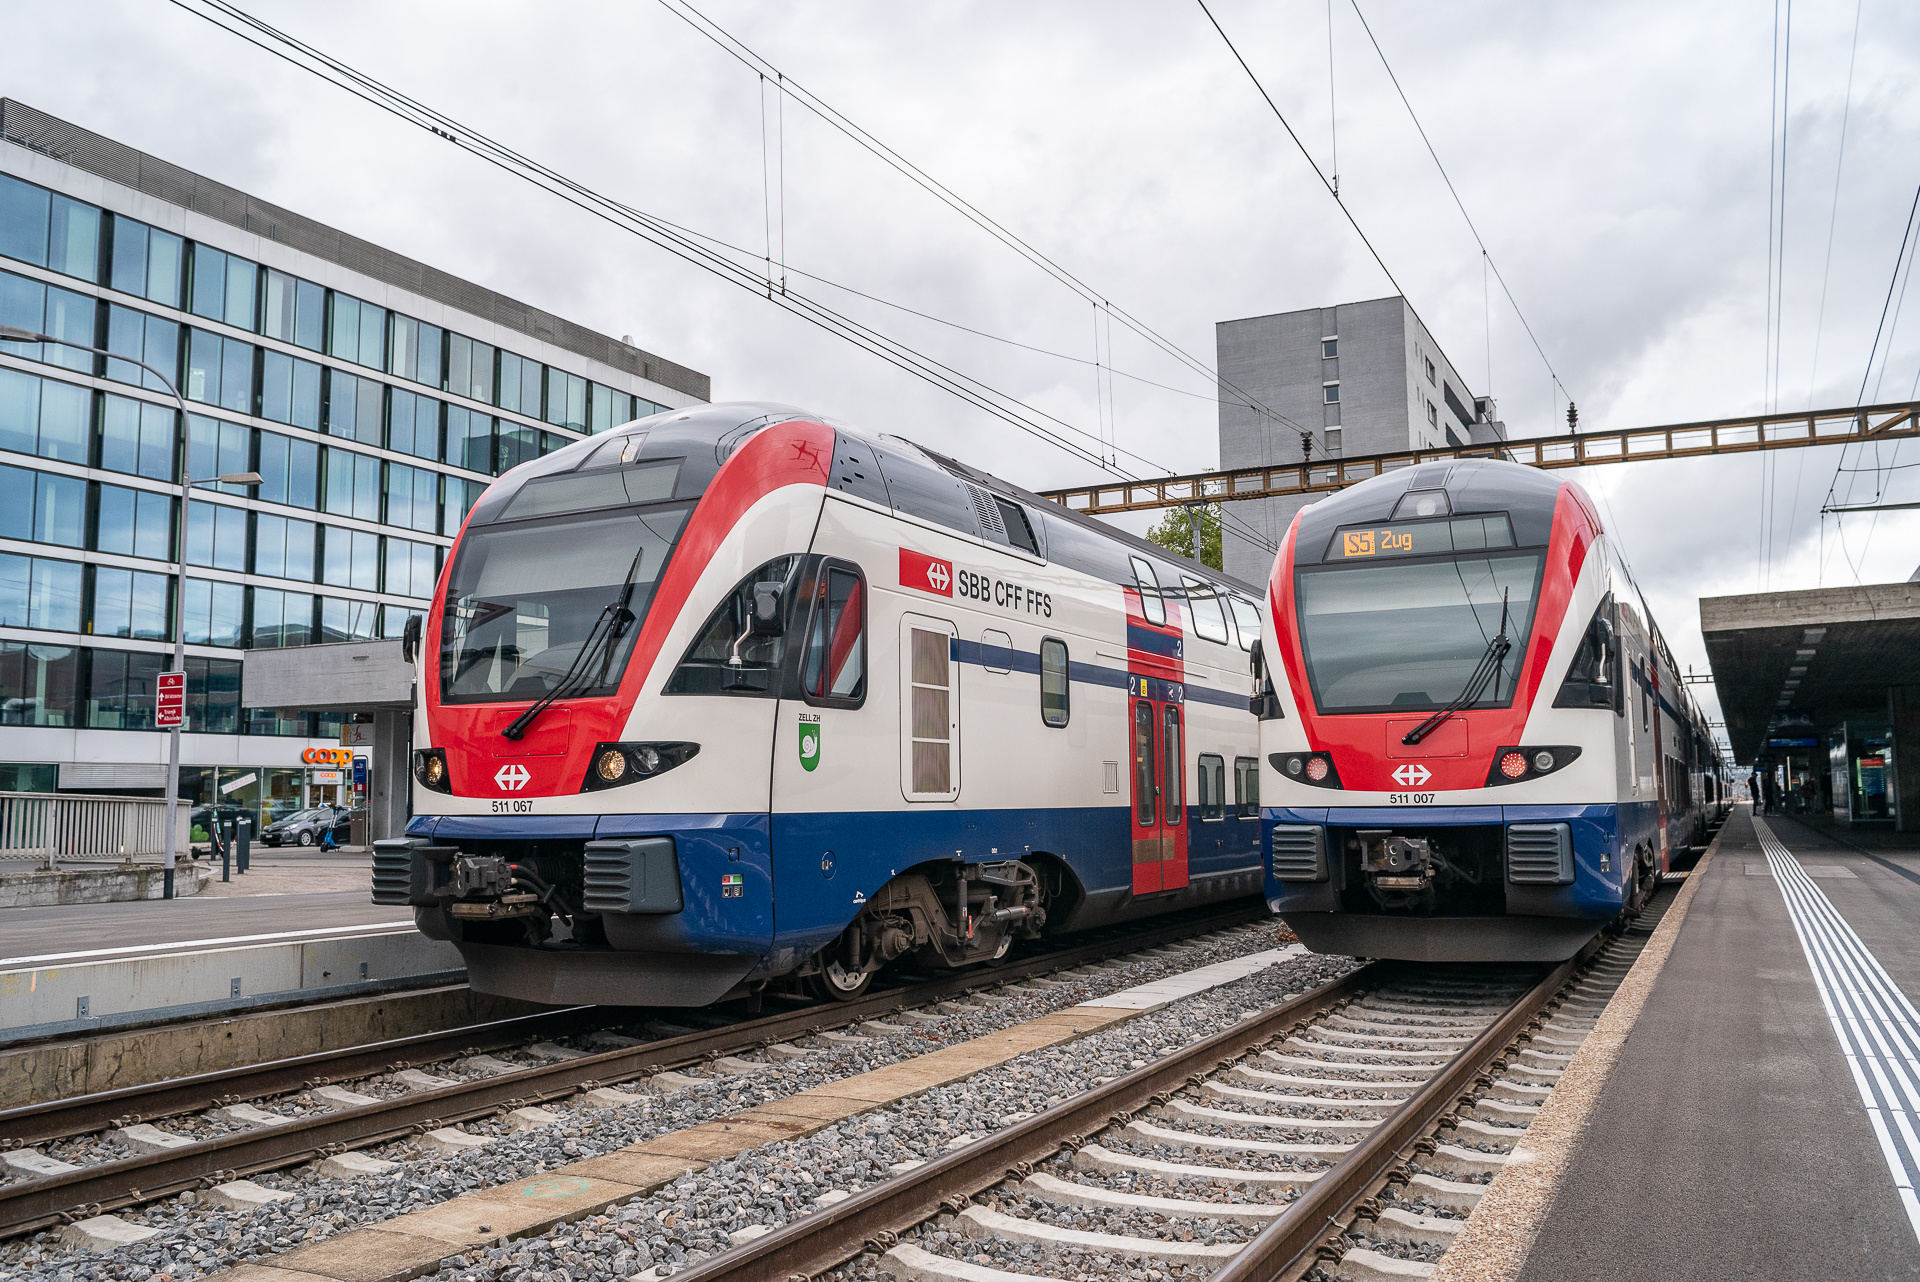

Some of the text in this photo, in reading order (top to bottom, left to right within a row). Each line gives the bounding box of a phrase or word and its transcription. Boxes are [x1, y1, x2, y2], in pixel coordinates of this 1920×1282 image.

[1348, 530, 1412, 553] S5 Zug
[958, 569, 1052, 618] SBB CFF FFS
[1176, 640, 1182, 657] 2
[1129, 676, 1136, 695] 2
[1178, 685, 1183, 703] 2
[798, 713, 821, 722] ZELL ZH
[303, 747, 353, 768] coop
[492, 800, 533, 812] 511 067
[1390, 793, 1435, 804] 511 007
